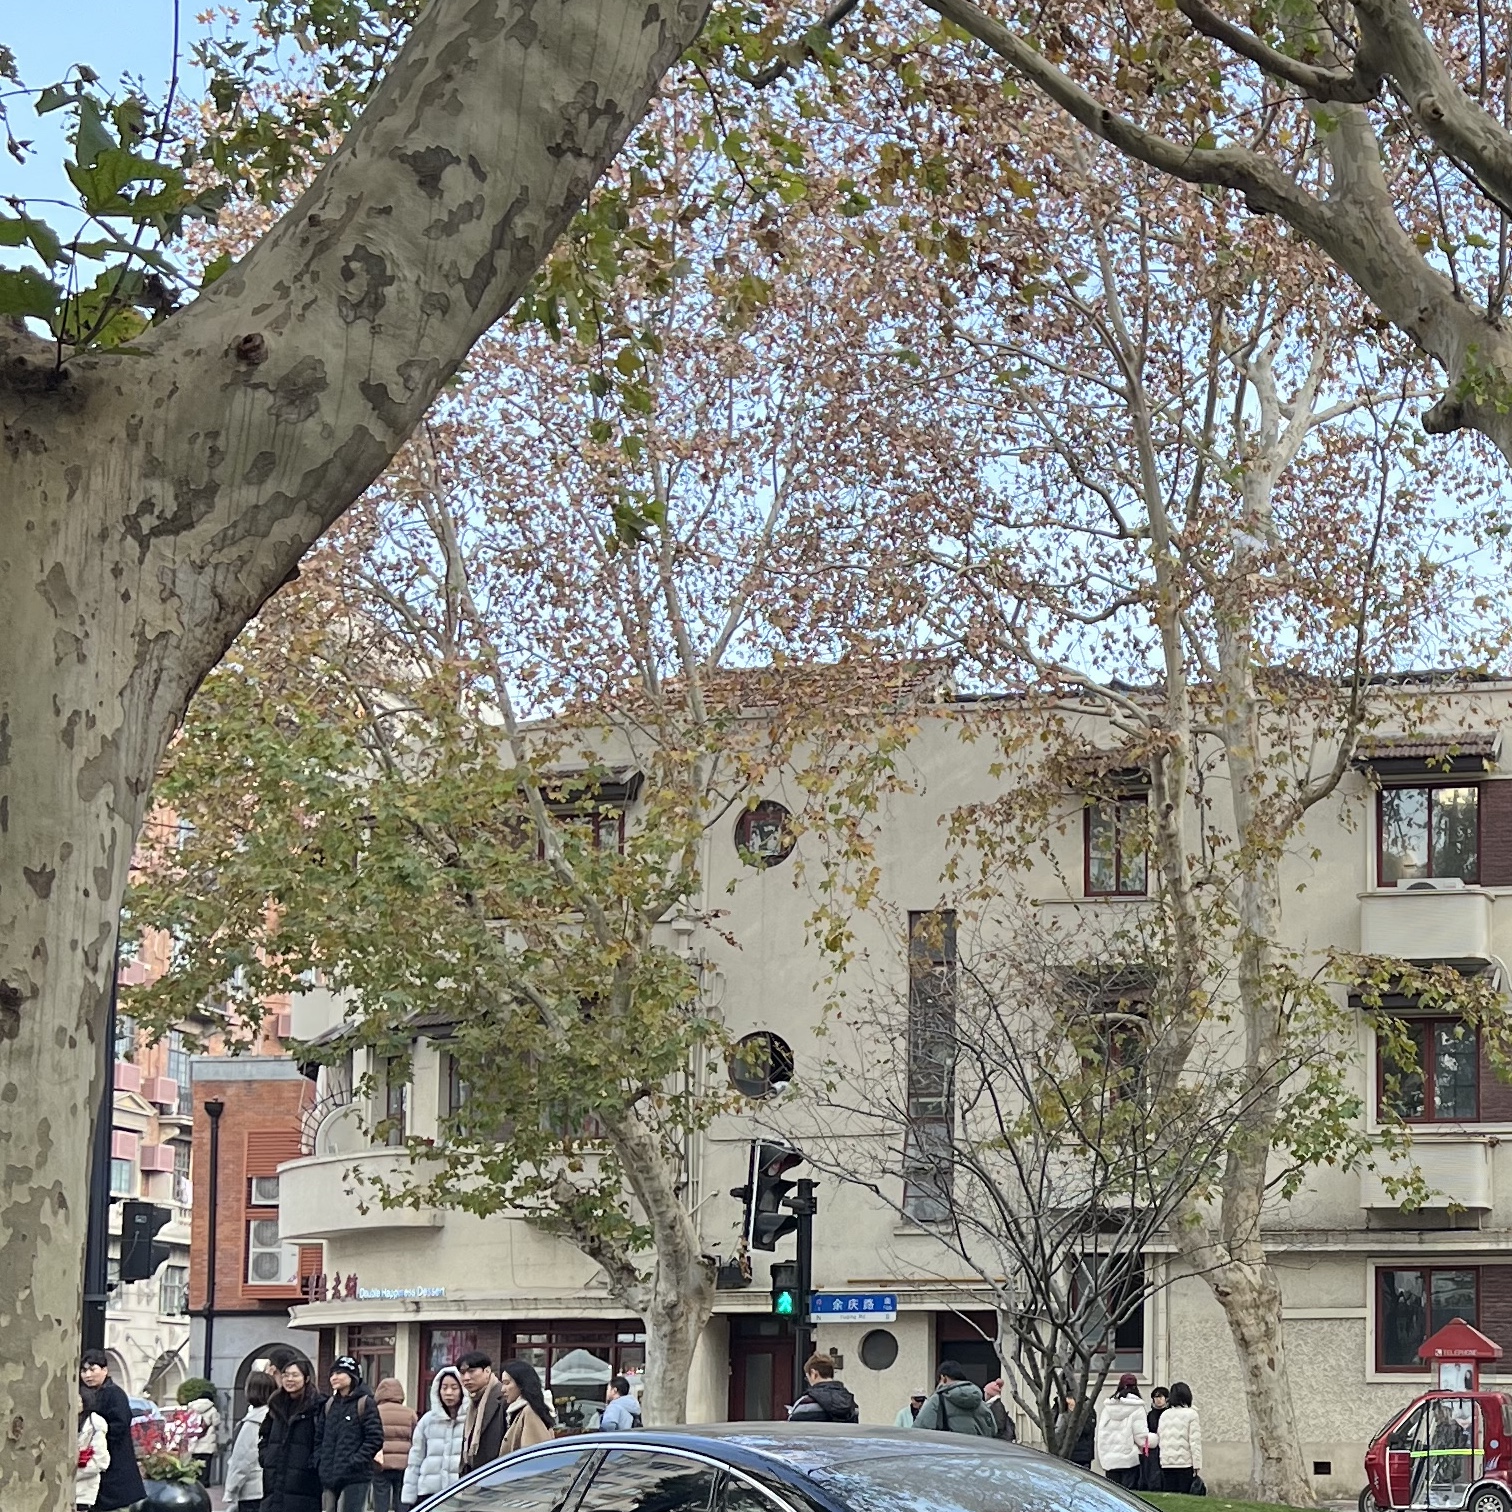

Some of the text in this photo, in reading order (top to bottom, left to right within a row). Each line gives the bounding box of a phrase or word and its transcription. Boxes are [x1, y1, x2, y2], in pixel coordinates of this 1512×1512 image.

[359, 1286, 446, 1300] Double Happiness Dessert
[832, 1298, 875, 1311] 余庆路
